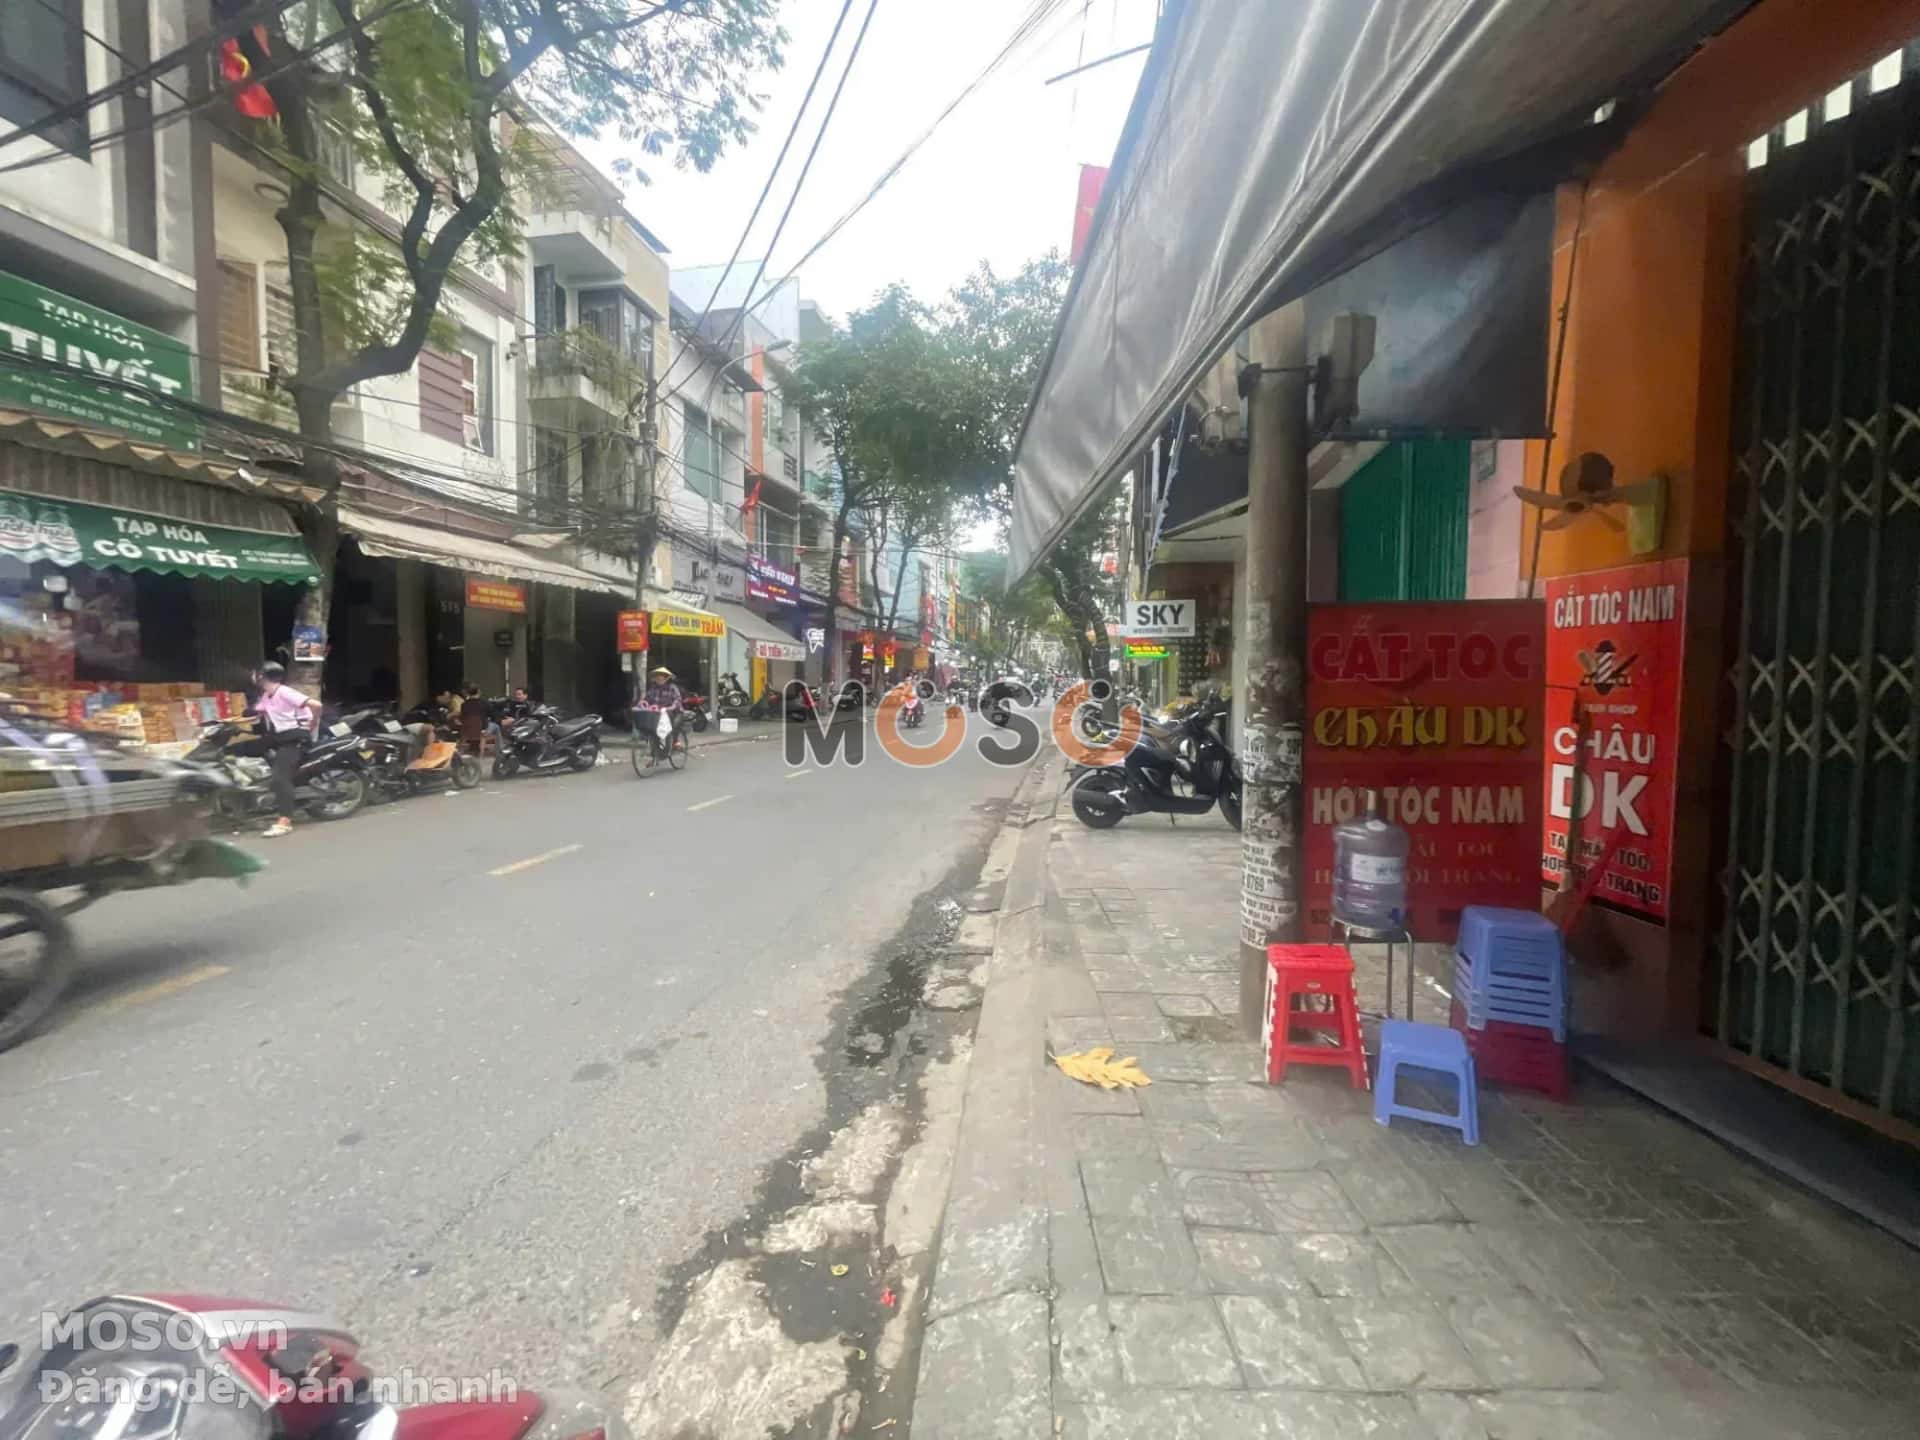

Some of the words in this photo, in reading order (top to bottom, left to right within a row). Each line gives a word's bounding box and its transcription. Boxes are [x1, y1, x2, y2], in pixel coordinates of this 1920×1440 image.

[112, 516, 158, 539] TẠP
[162, 525, 210, 545] HÓA
[93, 538, 143, 559] CÔ
[146, 545, 239, 569] TUYẾT
[1136, 604, 1185, 626] SKY
[1589, 585, 1622, 625] TÓC
[1627, 585, 1675, 623] NAM
[1424, 621, 1534, 682] TÓC
[1462, 705, 1527, 746] DK
[1383, 777, 1441, 825] TÓC
[1451, 785, 1525, 824] NAM
[1550, 763, 1649, 836] DK
